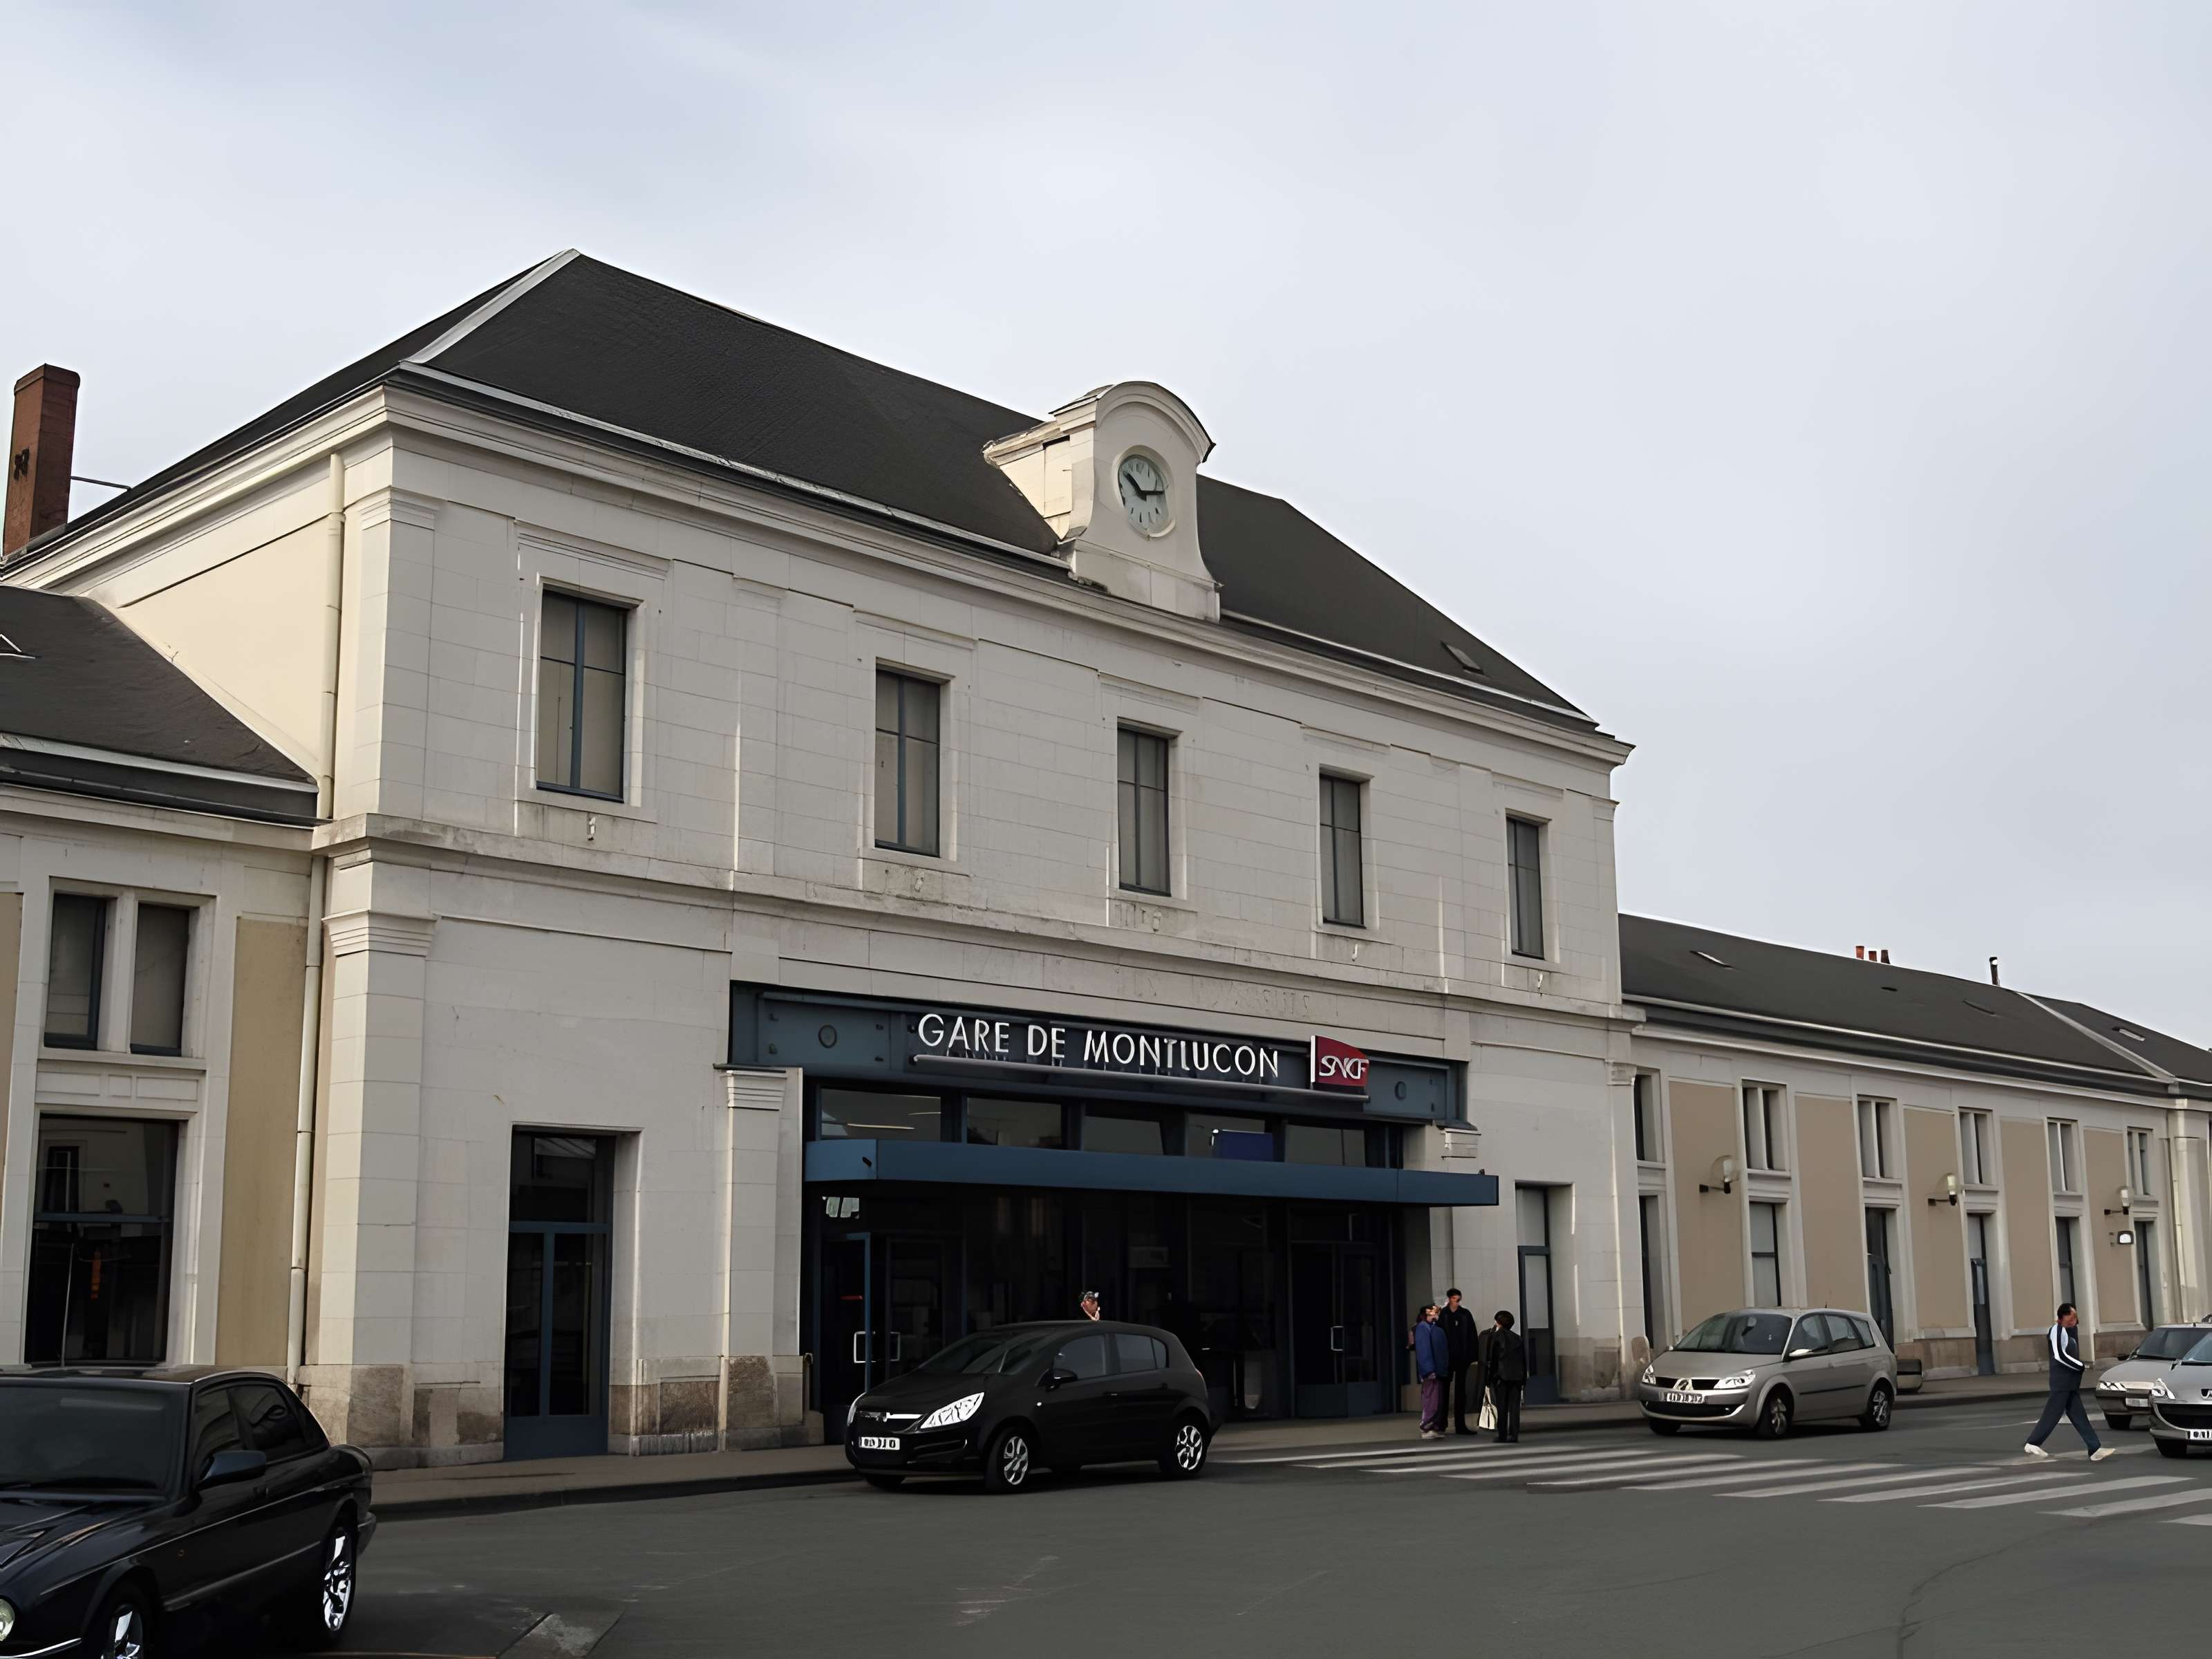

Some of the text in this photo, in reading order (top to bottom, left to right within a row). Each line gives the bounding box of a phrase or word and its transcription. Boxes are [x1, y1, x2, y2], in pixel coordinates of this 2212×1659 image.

[919, 1013, 1009, 1053] GARE
[1027, 1025, 1065, 1058] DE
[1318, 1056, 1369, 1080] SNCF
